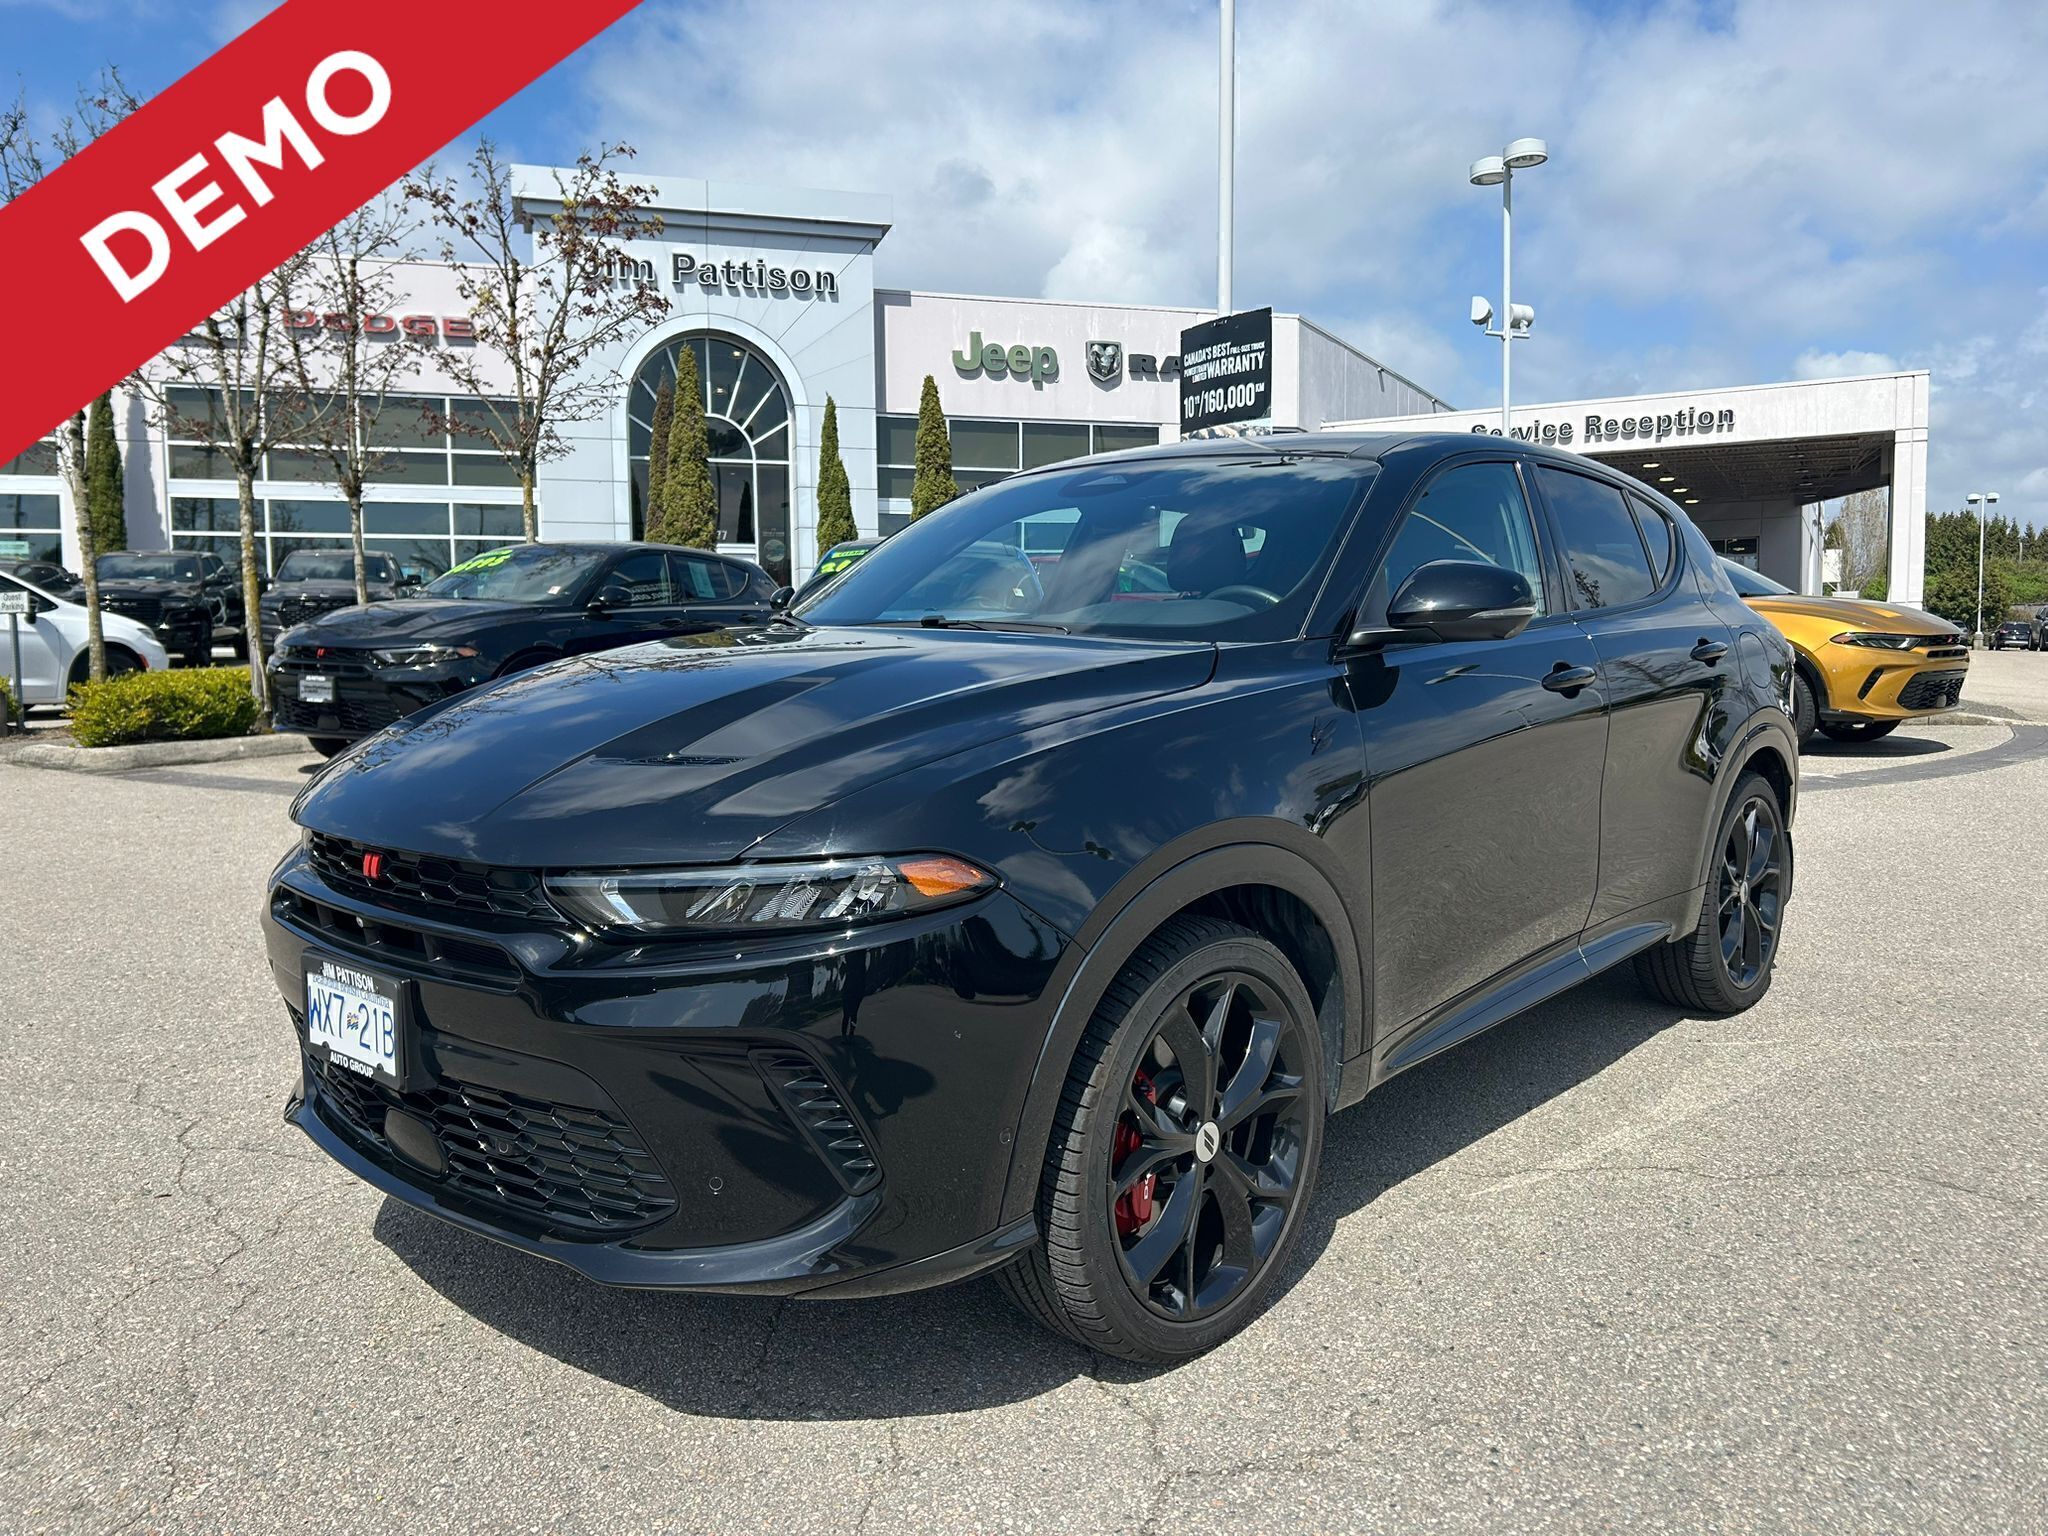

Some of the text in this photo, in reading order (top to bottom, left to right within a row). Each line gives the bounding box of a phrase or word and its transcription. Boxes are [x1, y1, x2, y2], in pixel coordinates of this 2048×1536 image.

[672, 252, 837, 294] Pattison
[283, 307, 474, 338] DODGE
[952, 331, 1059, 382] Jeep
[1184, 345, 1212, 367] CANADA'S
[1212, 341, 1231, 359] BEST
[1251, 340, 1266, 350] TRUCK
[1207, 350, 1266, 379] WARRANTY
[1585, 406, 1736, 437] Reception
[1, 602, 24, 611] Parking
[322, 961, 336, 979] JIM
[336, 965, 374, 992] PATTISON
[308, 985, 395, 1060] WX7 21B
[329, 1051, 375, 1078] AUTO GROUP
